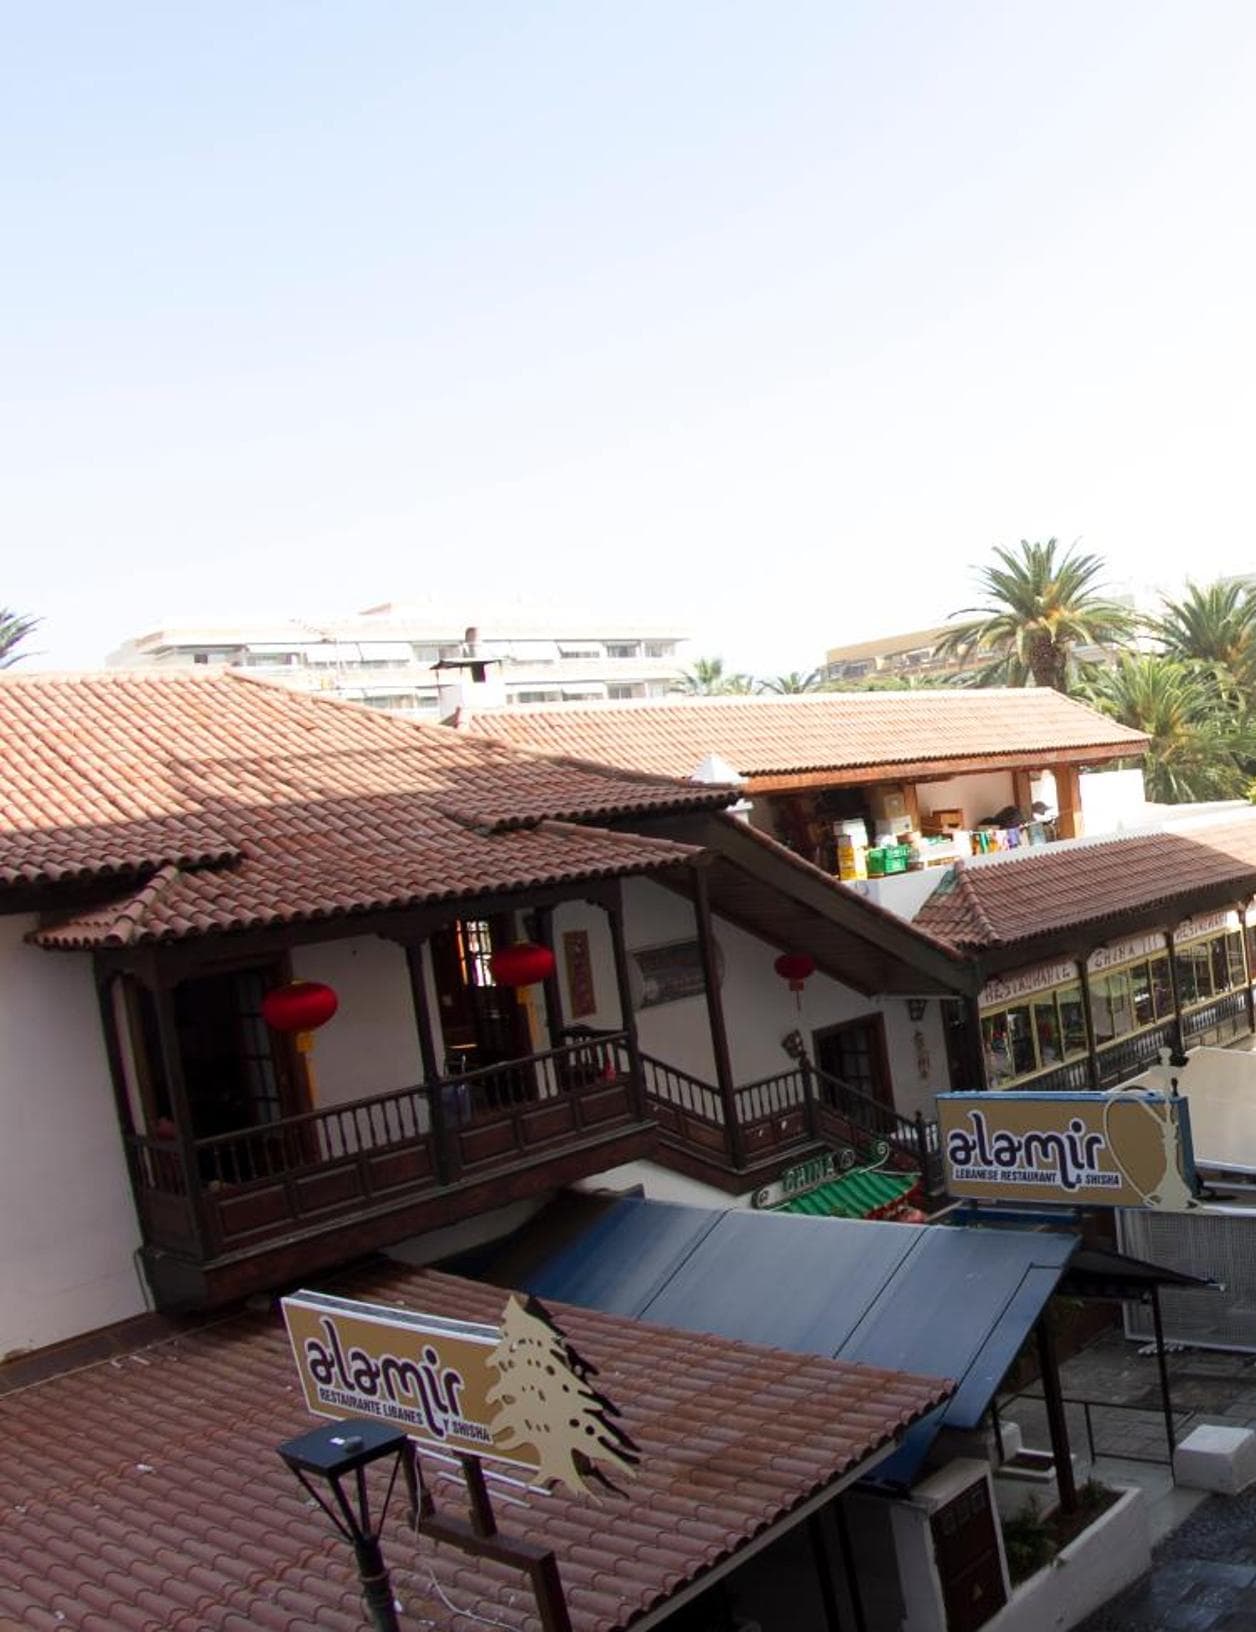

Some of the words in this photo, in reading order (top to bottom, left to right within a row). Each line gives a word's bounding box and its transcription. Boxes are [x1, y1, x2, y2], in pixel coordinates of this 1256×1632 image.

[949, 1111, 1102, 1190] alamir
[955, 1169, 999, 1181] LEBANESE
[1001, 1170, 1057, 1183] RESTAURANT
[1075, 1173, 1082, 1184] &
[1086, 1174, 1119, 1185] SHISHA
[305, 1317, 463, 1438] alamir
[319, 1387, 382, 1416] RESTAURANTE
[443, 1418, 449, 1432] Y
[452, 1421, 491, 1441] SHISHA
